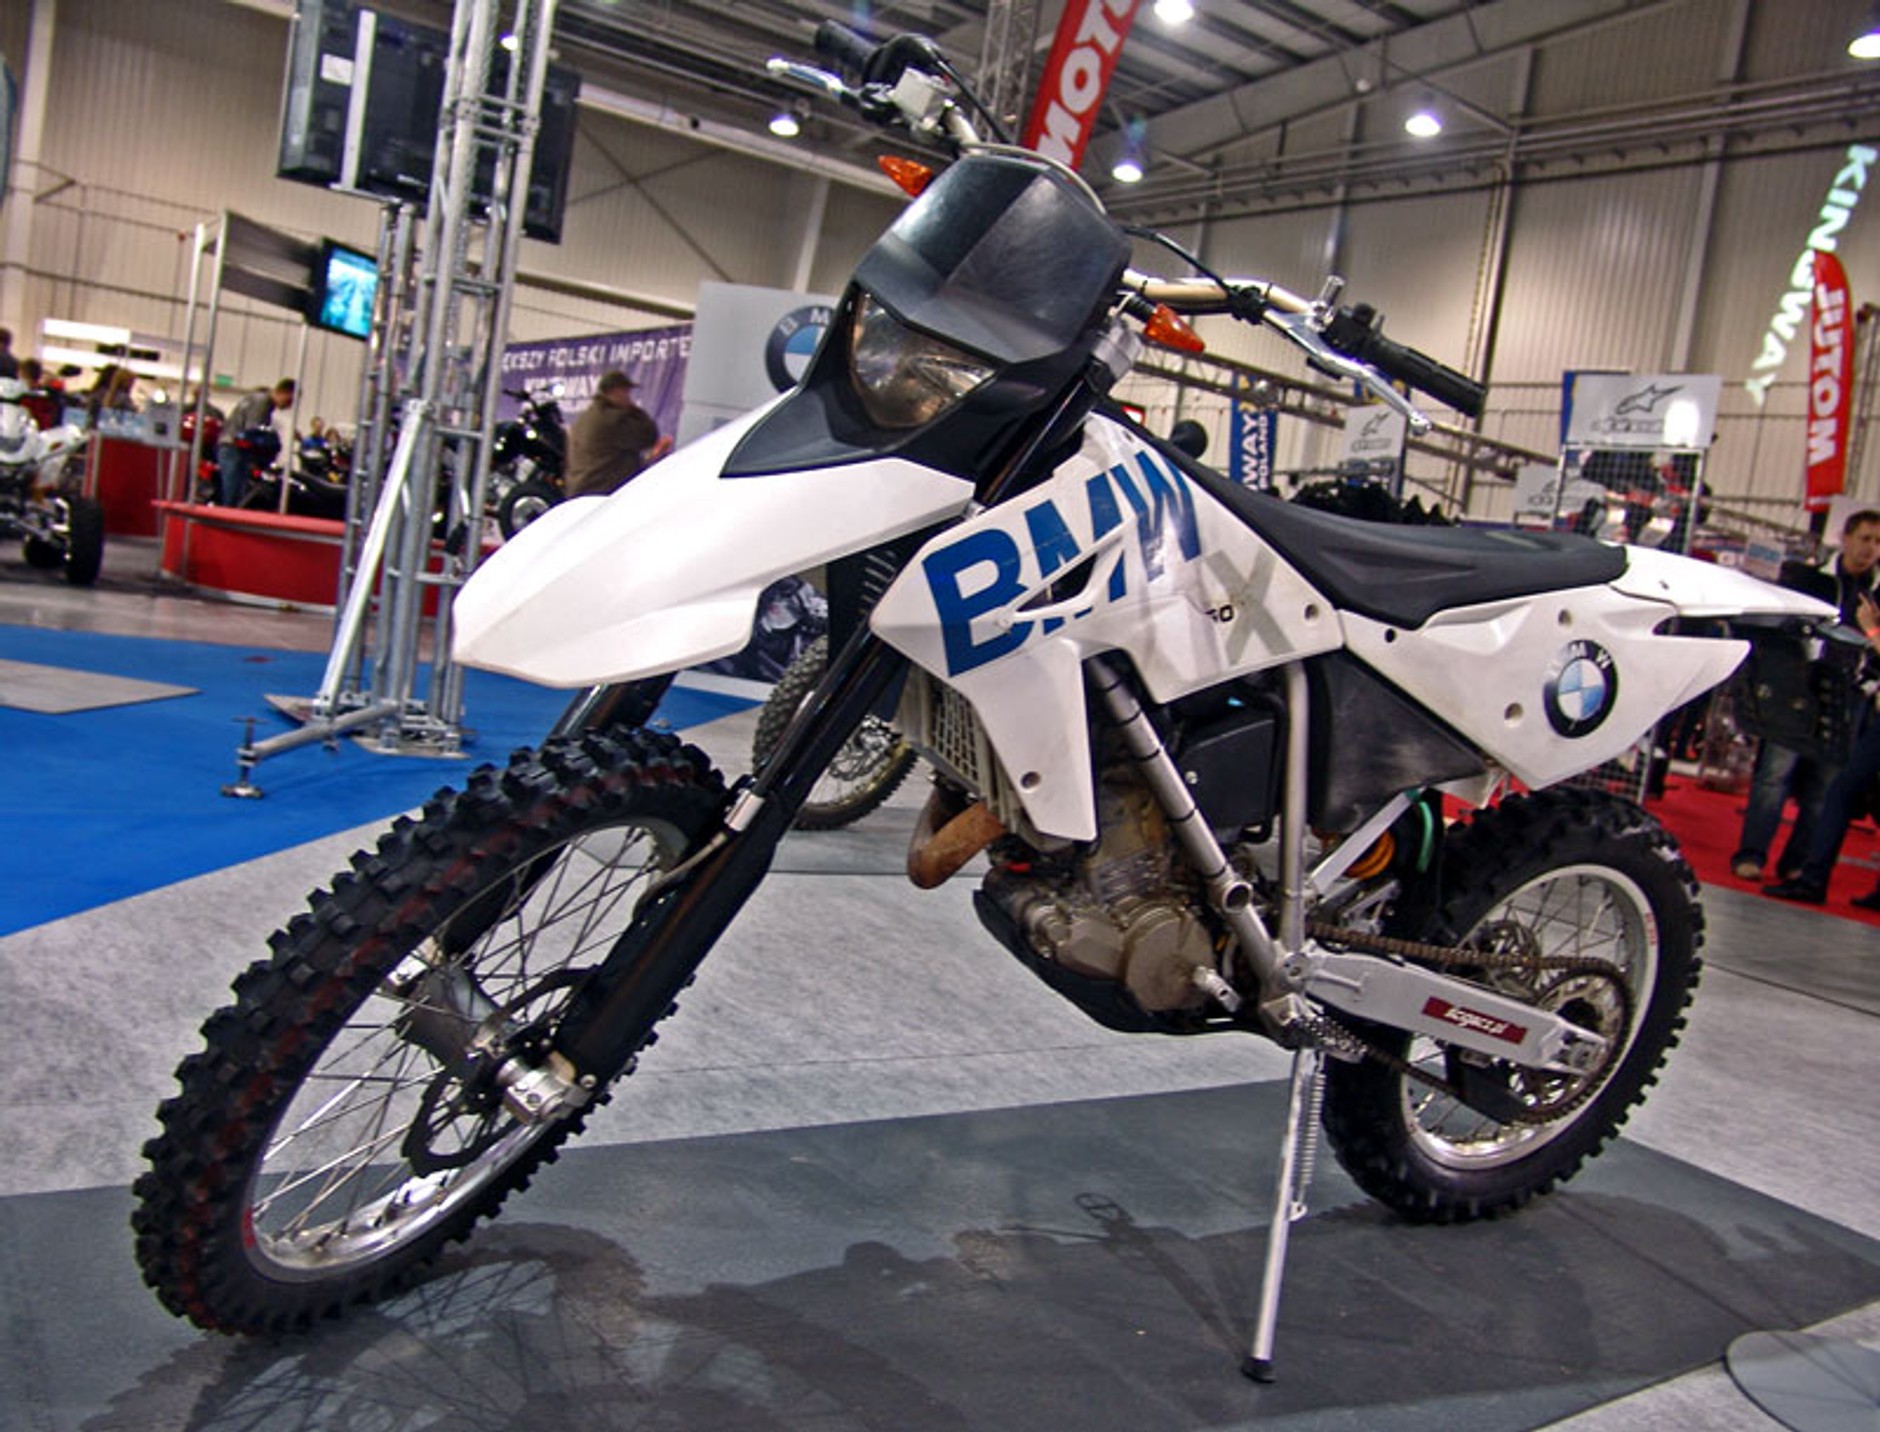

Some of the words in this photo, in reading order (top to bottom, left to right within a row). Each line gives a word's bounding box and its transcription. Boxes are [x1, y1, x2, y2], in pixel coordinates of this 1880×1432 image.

[1745, 144, 1878, 406] KINGWAY
[548, 344, 605, 368] POLSKI
[1241, 413, 1258, 492] WAY
[1257, 414, 1269, 490] POLAND
[922, 450, 1201, 678] BMW
